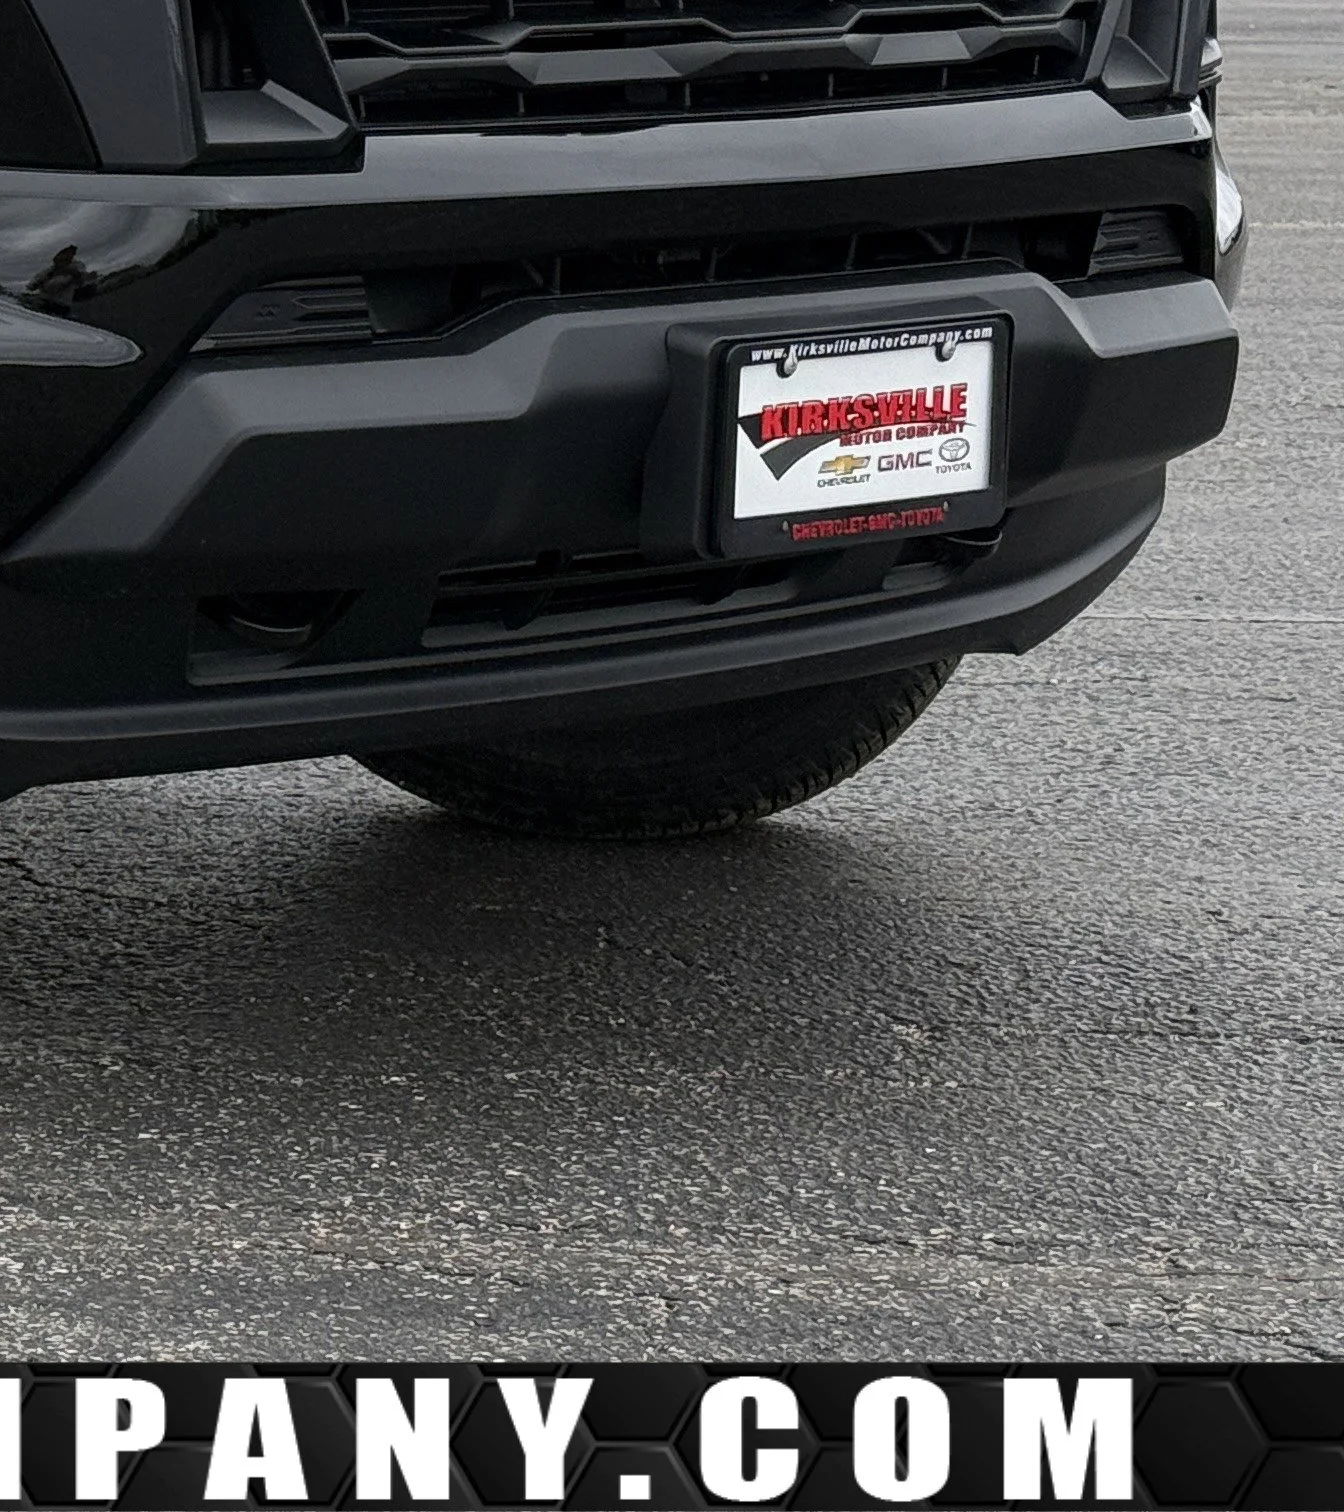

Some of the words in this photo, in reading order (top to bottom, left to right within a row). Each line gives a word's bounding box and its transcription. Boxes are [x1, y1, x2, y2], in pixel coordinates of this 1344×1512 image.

[760, 383, 969, 441] KIRKSVILLE
[839, 430, 893, 448] MOTOR
[896, 421, 967, 443] COMPANY
[877, 449, 933, 473] GMC
[935, 462, 972, 474] TOYOTA
